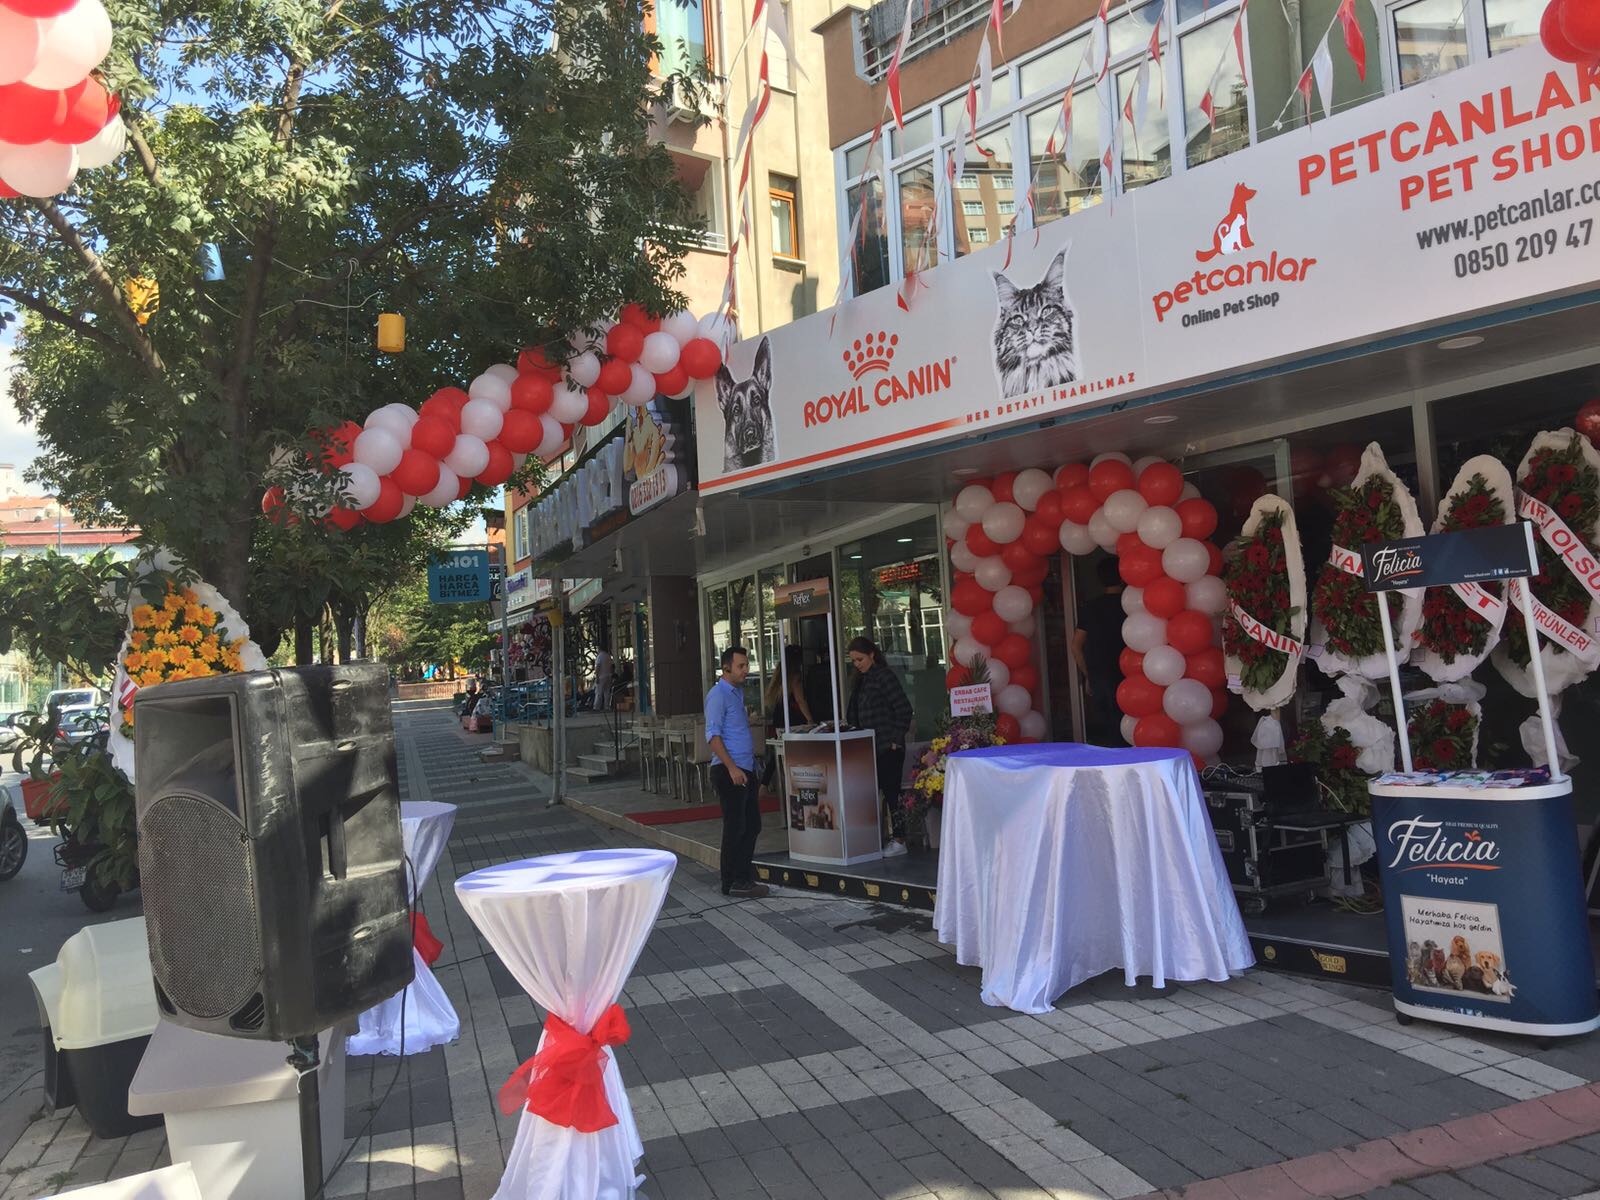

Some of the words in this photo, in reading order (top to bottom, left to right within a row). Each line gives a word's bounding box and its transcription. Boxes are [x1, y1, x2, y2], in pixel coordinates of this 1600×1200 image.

[1399, 154, 1479, 211] PET
[1453, 241, 1509, 278] 0850
[1515, 228, 1557, 263] 209
[1565, 217, 1593, 248] 47
[1152, 250, 1318, 323] petcanlar
[1181, 307, 1221, 328] Online
[1222, 299, 1246, 317] Pet
[1246, 291, 1280, 311] Shop
[803, 385, 870, 428] ROYAL
[966, 409, 990, 423] HER
[997, 395, 1045, 416] DETAYI
[1053, 372, 1136, 402] İNANILMAZ
[1372, 545, 1423, 583] Felicia
[1240, 613, 1303, 659] CANIN
[1387, 814, 1500, 869] Felicia
[1426, 873, 1469, 886] "Hayata"
[1417, 908, 1452, 920] Merhaba
